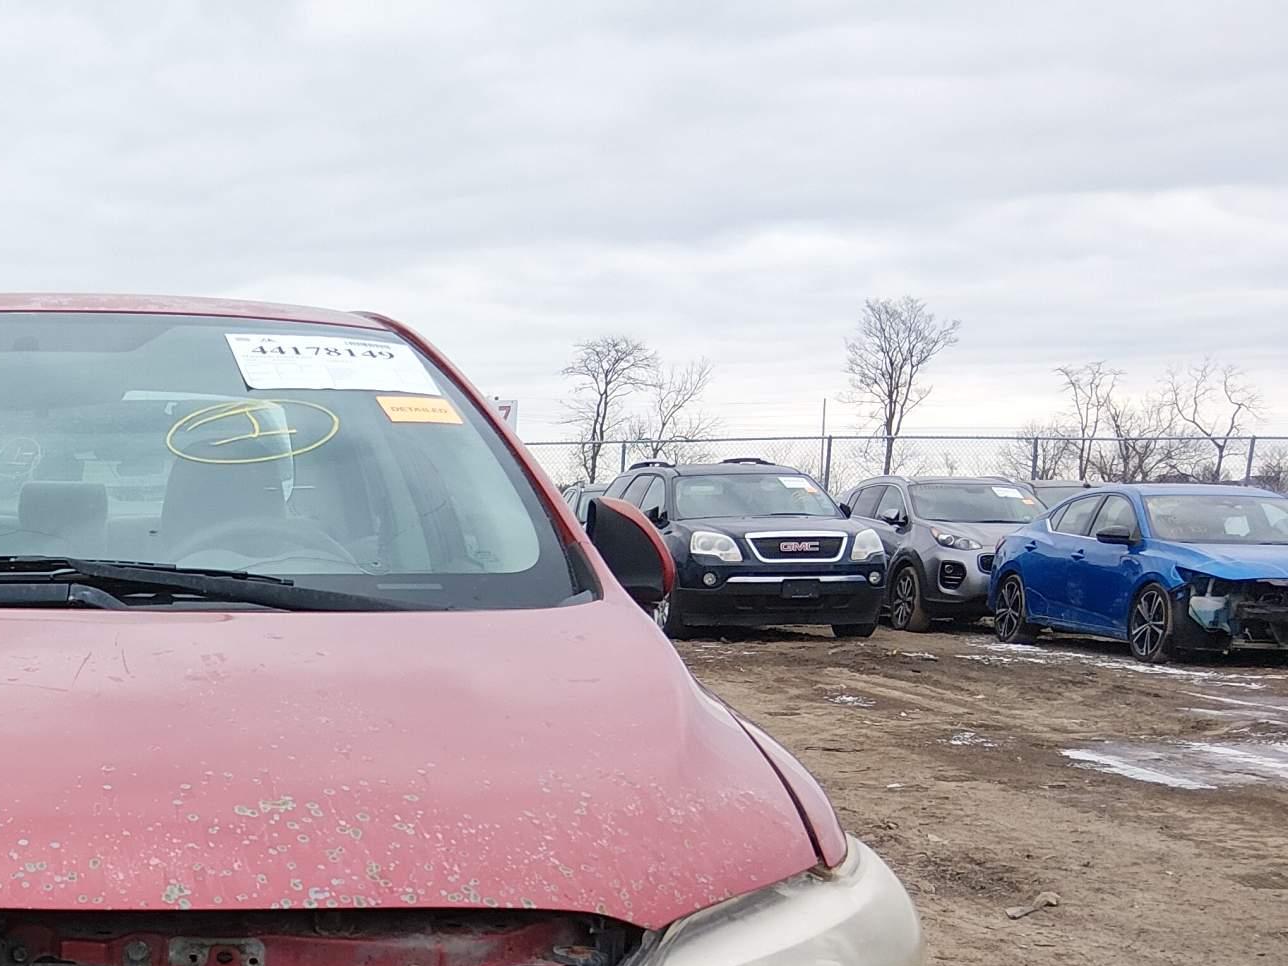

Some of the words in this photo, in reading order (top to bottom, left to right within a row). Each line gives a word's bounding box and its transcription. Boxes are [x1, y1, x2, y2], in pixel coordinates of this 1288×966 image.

[250, 345, 395, 360] 44178149
[498, 405, 512, 421] 7
[779, 541, 820, 552] GMC
